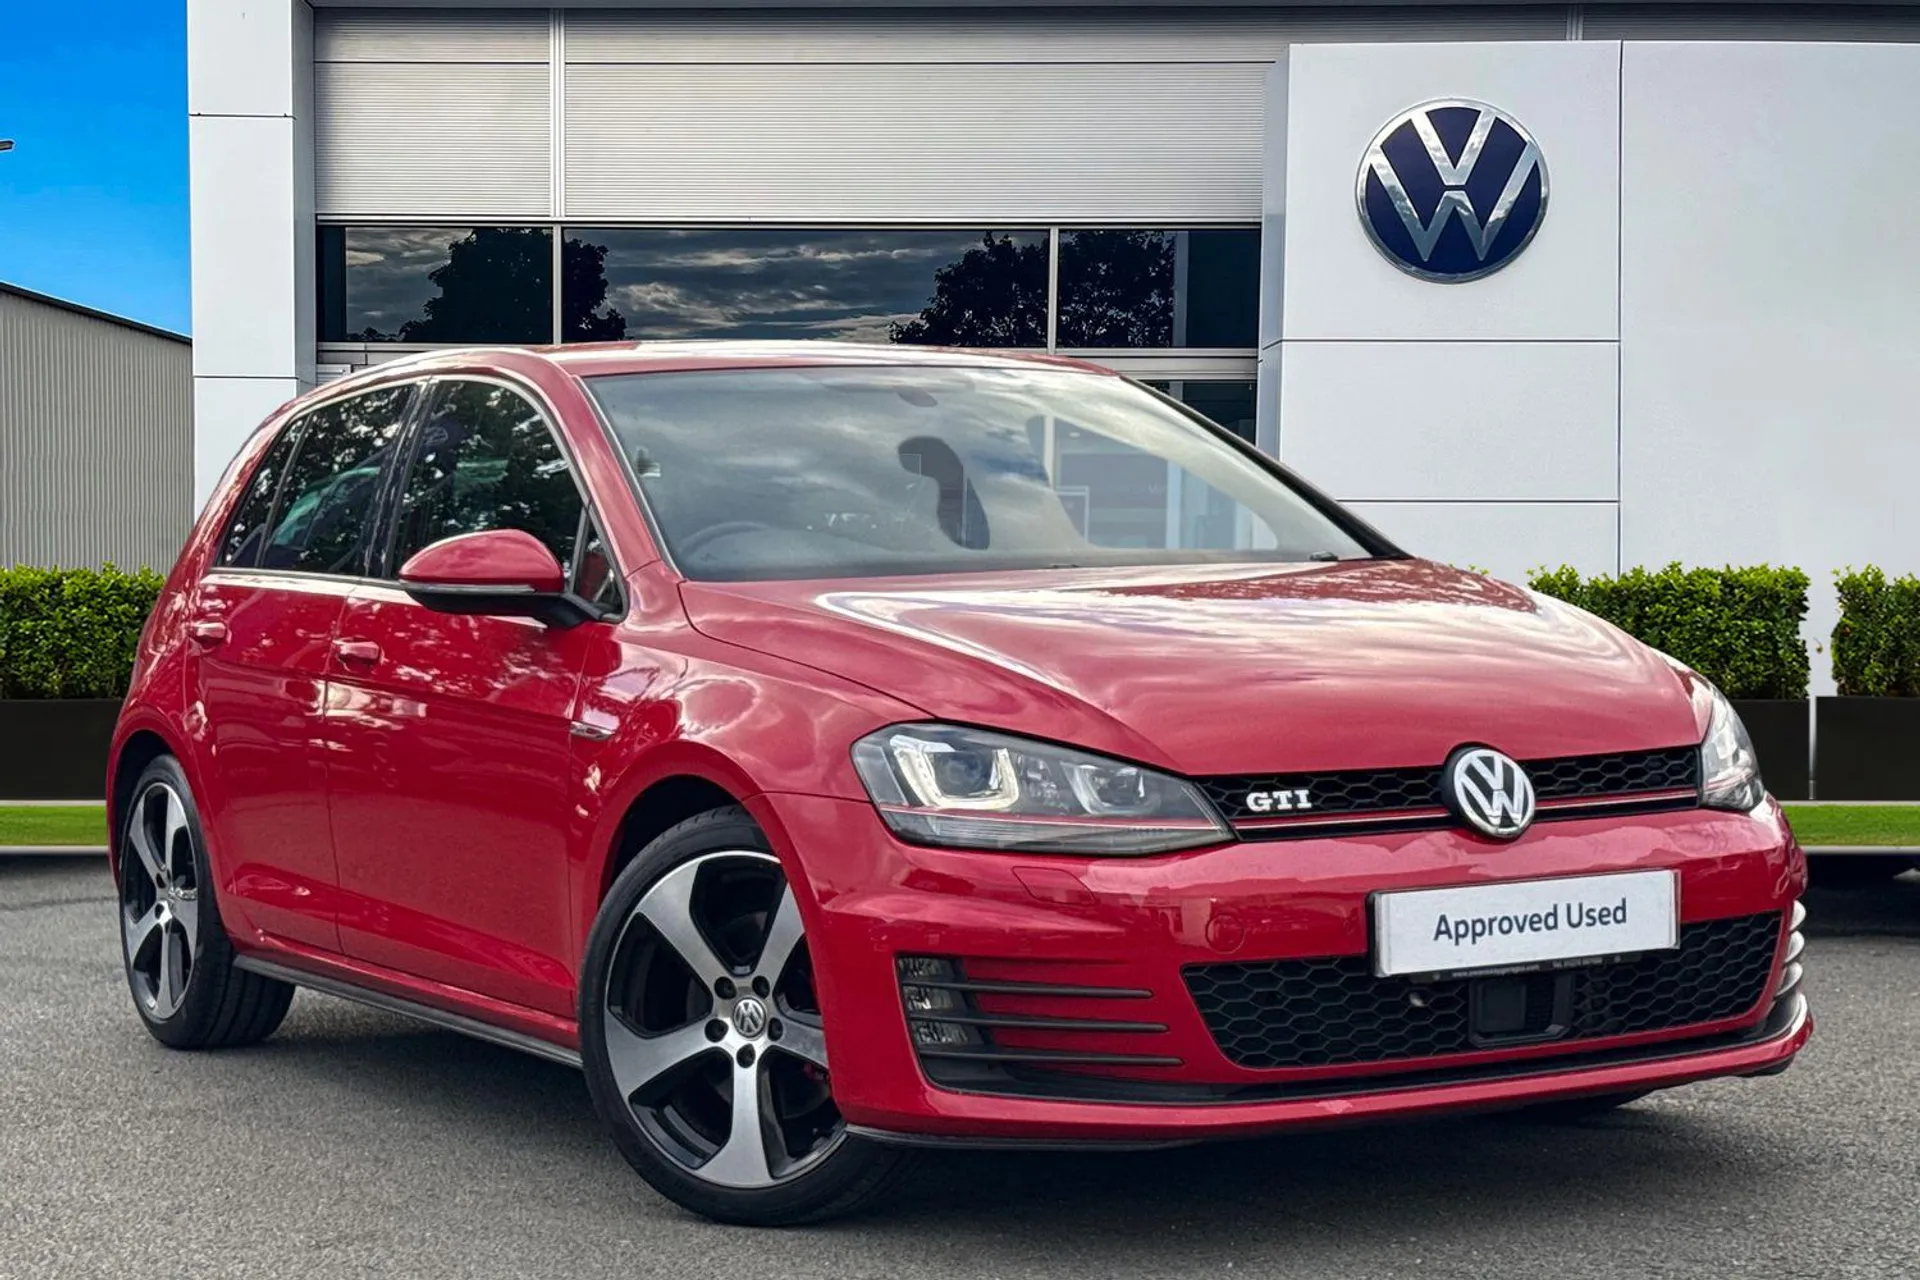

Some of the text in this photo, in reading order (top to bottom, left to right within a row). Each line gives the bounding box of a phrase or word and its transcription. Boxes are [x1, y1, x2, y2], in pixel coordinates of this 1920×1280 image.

[1359, 102, 1544, 272] VW
[1245, 788, 1313, 812] GTI
[1454, 748, 1535, 837] VW
[1433, 897, 1627, 946] Approved Used
